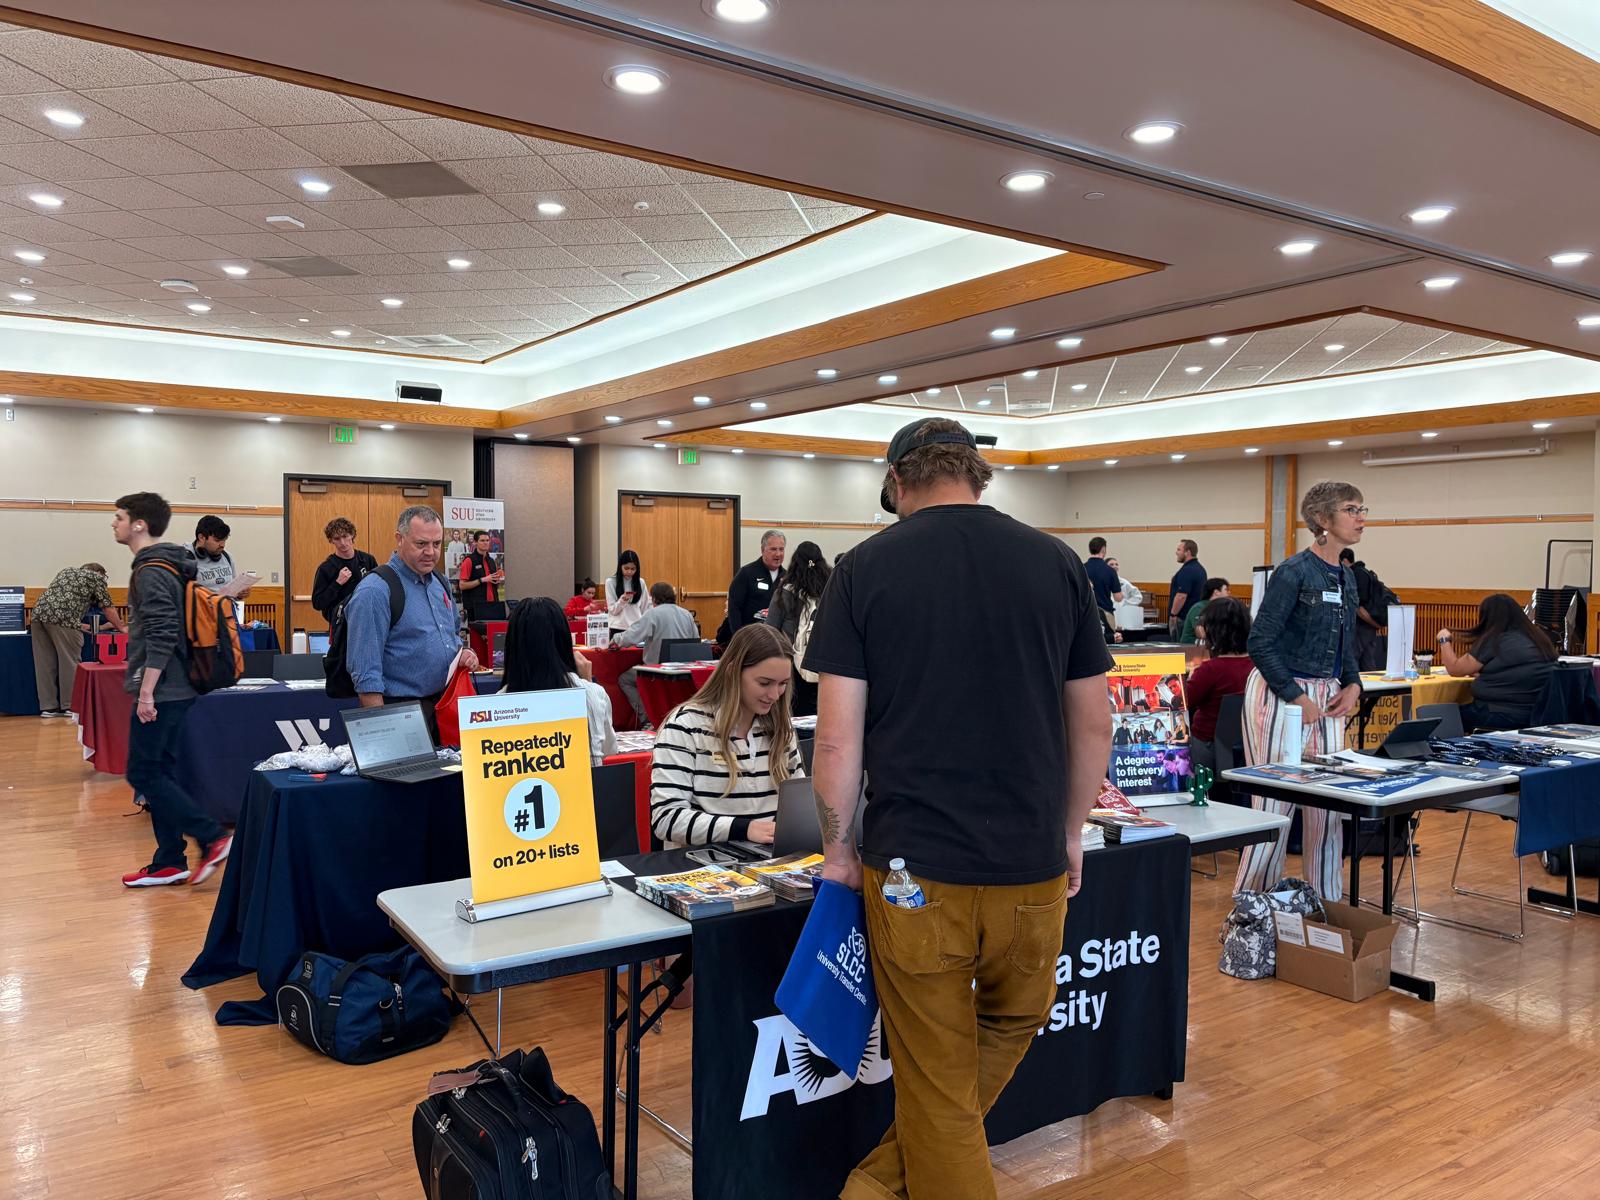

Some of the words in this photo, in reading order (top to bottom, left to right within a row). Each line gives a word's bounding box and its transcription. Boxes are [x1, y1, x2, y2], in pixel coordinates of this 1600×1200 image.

[451, 506, 475, 521] SUU
[1108, 664, 1123, 673] SU
[470, 710, 493, 723] ASU
[481, 731, 572, 756] Repeatedly
[483, 748, 565, 779] ranked
[1115, 756, 1123, 766] A
[1123, 756, 1156, 767] degree
[1116, 768, 1126, 777] to
[1127, 767, 1137, 776] fit
[1137, 767, 1163, 776] every
[1117, 776, 1152, 788] interest
[514, 784, 546, 832] #1
[493, 855, 514, 869] on
[516, 848, 546, 865] 20+
[548, 843, 580, 859] lists
[836, 942, 866, 983] SLCC
[1079, 930, 1161, 978] State
[816, 949, 840, 979] University
[839, 971, 855, 993] Transfer
